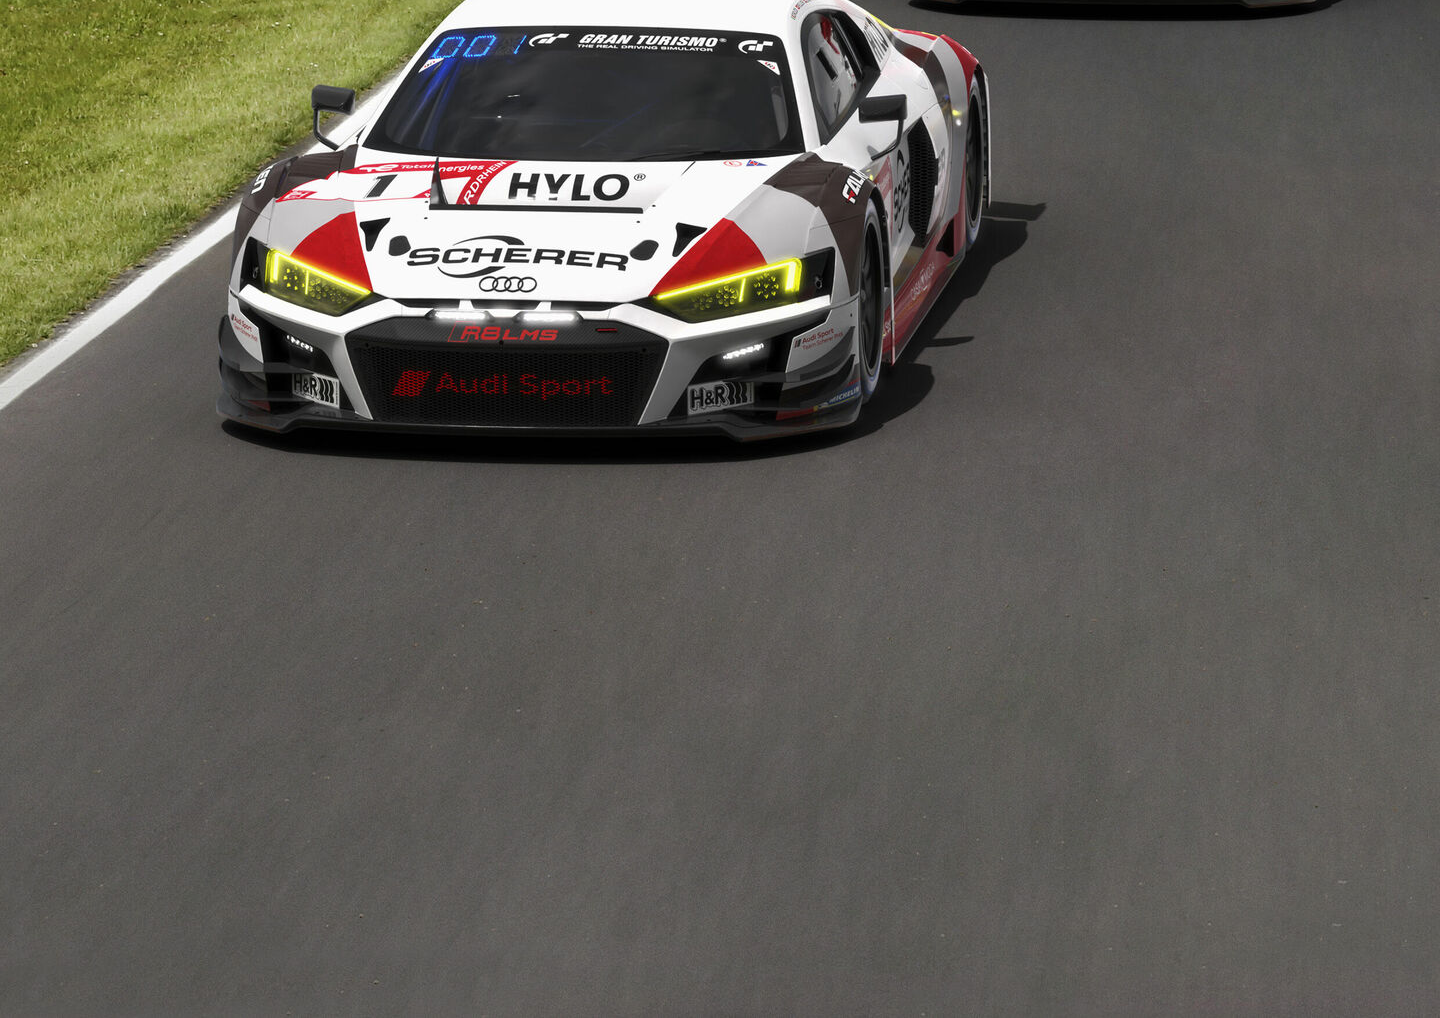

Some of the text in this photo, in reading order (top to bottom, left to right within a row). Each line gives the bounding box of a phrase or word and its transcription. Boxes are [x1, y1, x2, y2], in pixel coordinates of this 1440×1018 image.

[579, 33, 633, 45] GRAN
[407, 246, 631, 272] SCHERER
[802, 327, 834, 344] Audi Sport
[294, 373, 318, 397] H&R
[435, 372, 613, 401] Audi Sport
[690, 384, 727, 411] H&R
